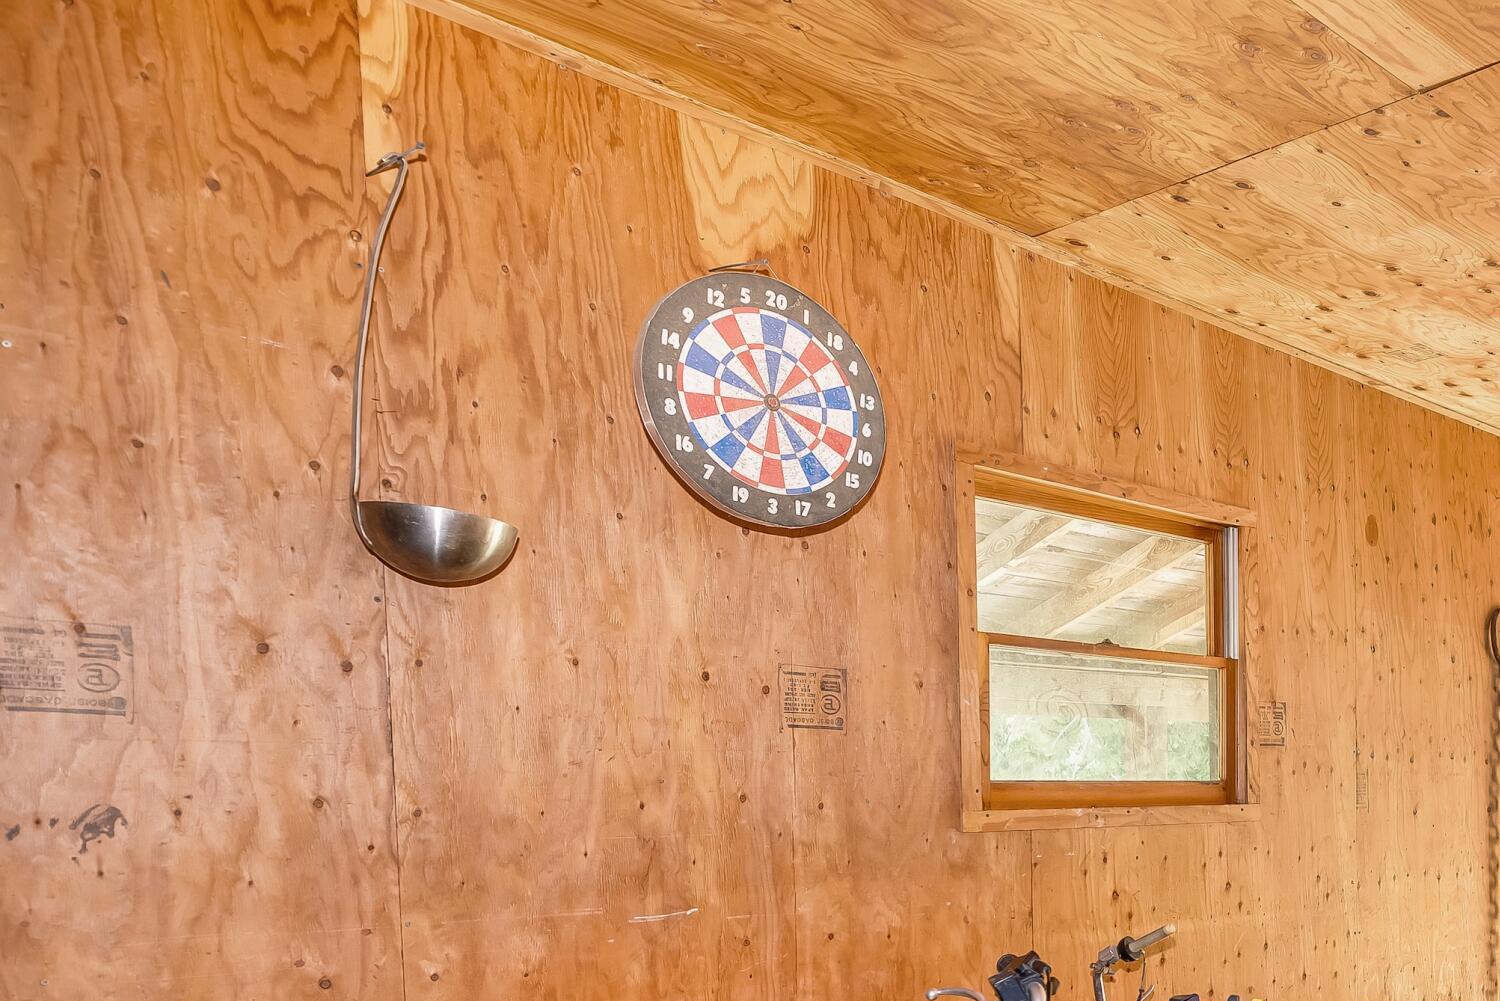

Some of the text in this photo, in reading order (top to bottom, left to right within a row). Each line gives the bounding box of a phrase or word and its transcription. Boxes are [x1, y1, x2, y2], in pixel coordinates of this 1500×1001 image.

[707, 287, 725, 309] 12
[739, 287, 751, 305] 5
[765, 289, 788, 311] 20
[682, 306, 695, 324] 9
[803, 309, 810, 326] 1
[661, 328, 681, 350] 14
[826, 331, 844, 351] 18
[657, 362, 673, 382] 11
[848, 360, 859, 377] 4
[664, 397, 677, 416] 8
[859, 393, 875, 411] 13
[861, 422, 872, 438] 6
[675, 433, 694, 453] 16
[857, 449, 873, 467] 10
[703, 463, 715, 480] 7
[845, 471, 860, 489] 15
[732, 485, 749, 503] 19
[825, 491, 836, 508] 2
[767, 498, 778, 515] 3
[795, 499, 812, 517] 17
